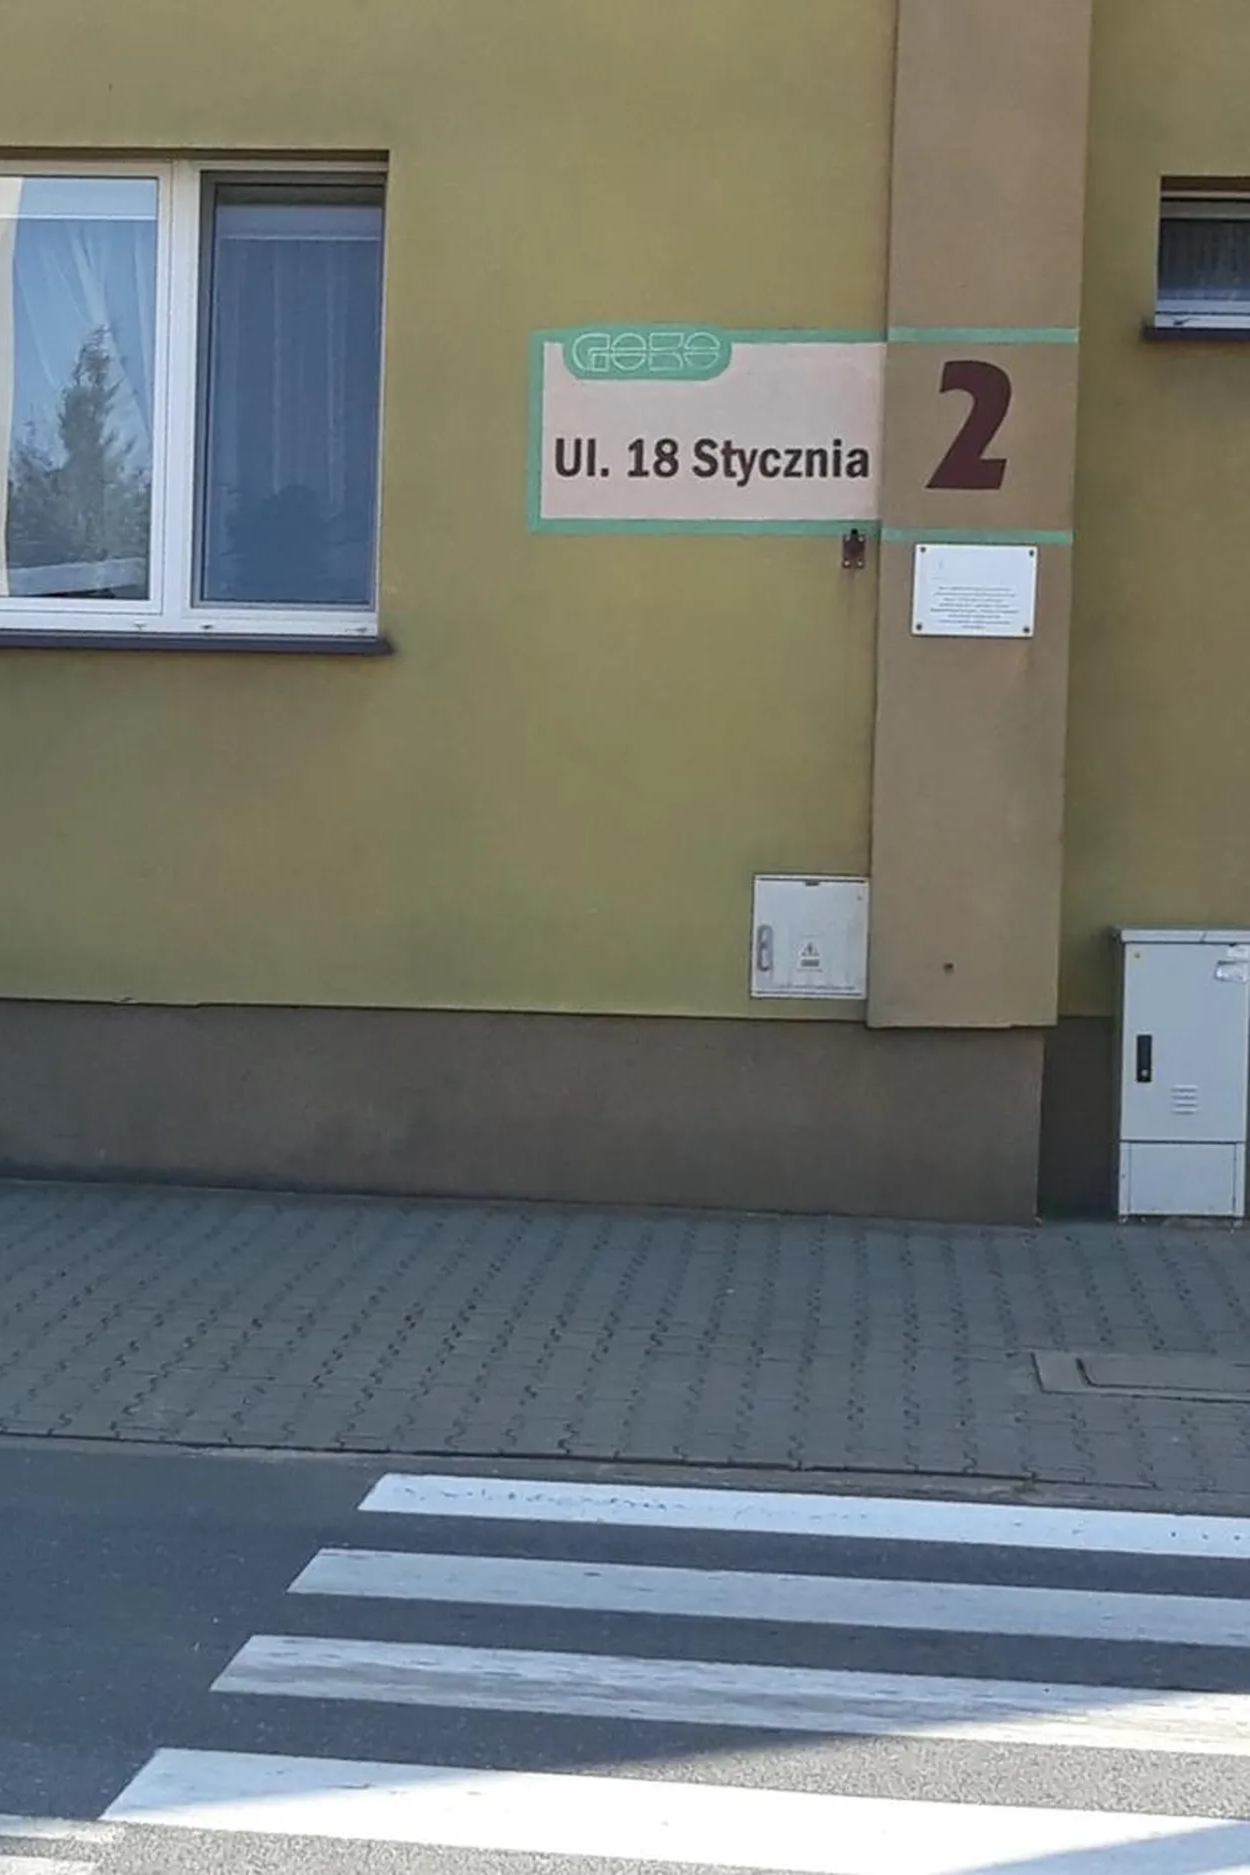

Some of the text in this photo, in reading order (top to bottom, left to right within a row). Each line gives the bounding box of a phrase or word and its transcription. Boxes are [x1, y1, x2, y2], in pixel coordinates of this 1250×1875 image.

[554, 437, 870, 487] Ul. 18 Stycznia
[925, 360, 1012, 490] 2
